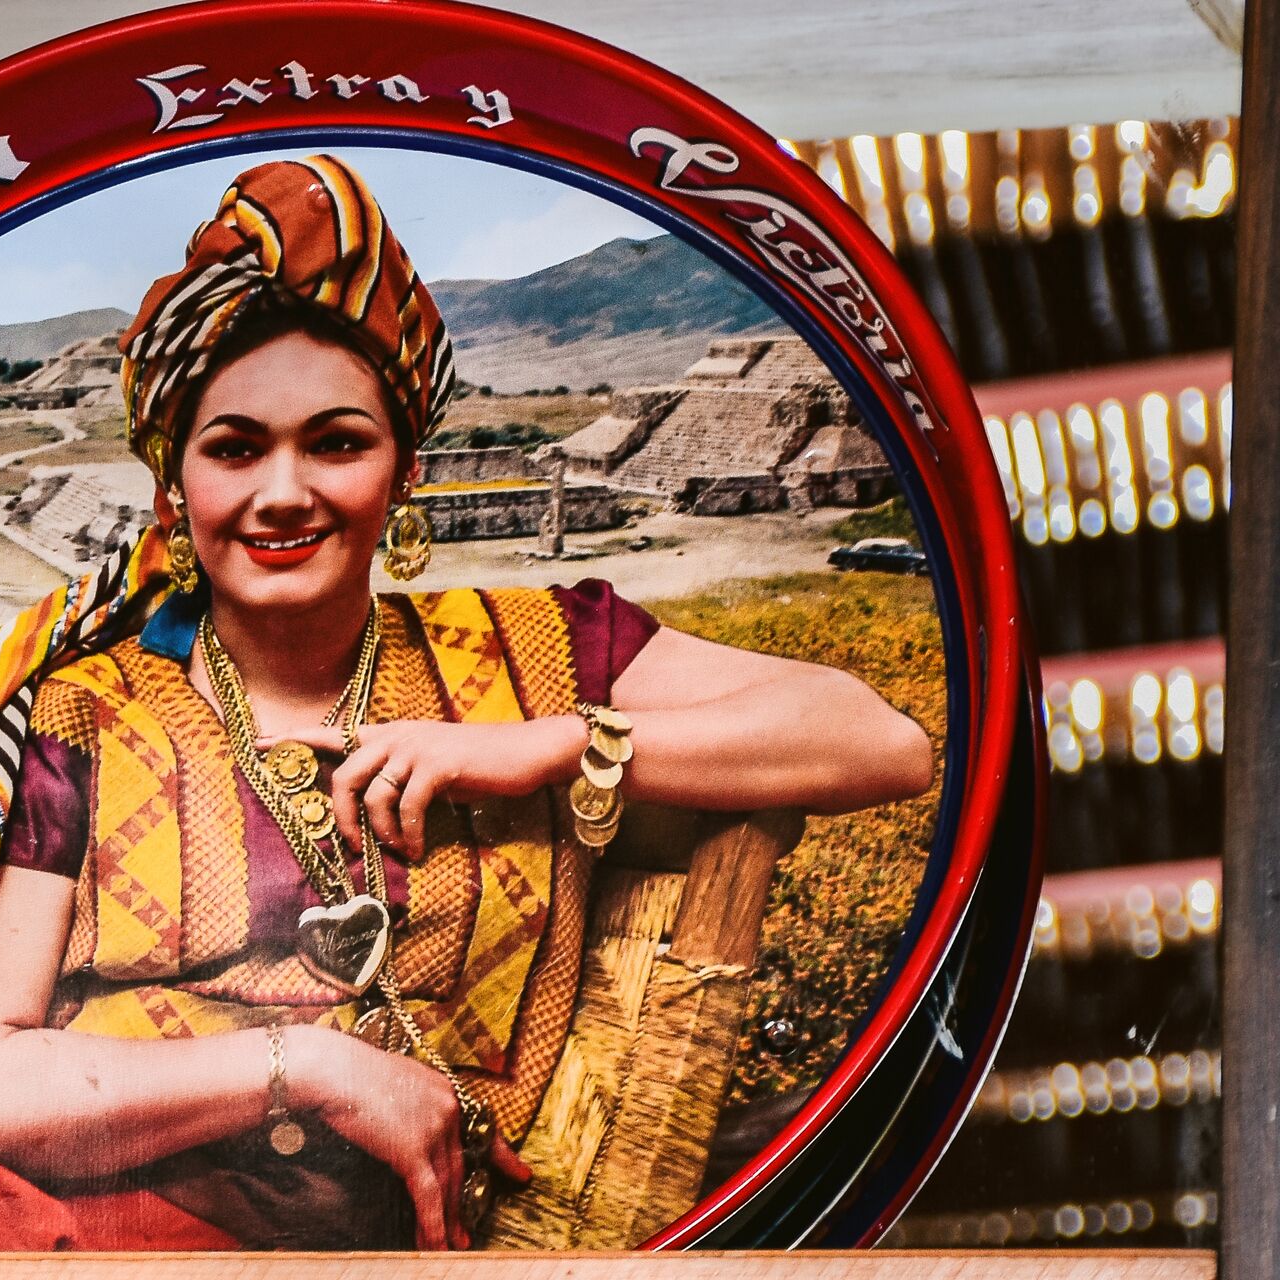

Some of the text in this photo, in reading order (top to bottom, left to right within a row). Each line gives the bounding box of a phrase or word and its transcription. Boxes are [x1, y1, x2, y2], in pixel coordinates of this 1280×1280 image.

[135, 59, 431, 134] Extra
[460, 83, 515, 130] y
[629, 126, 950, 440] Victoria
